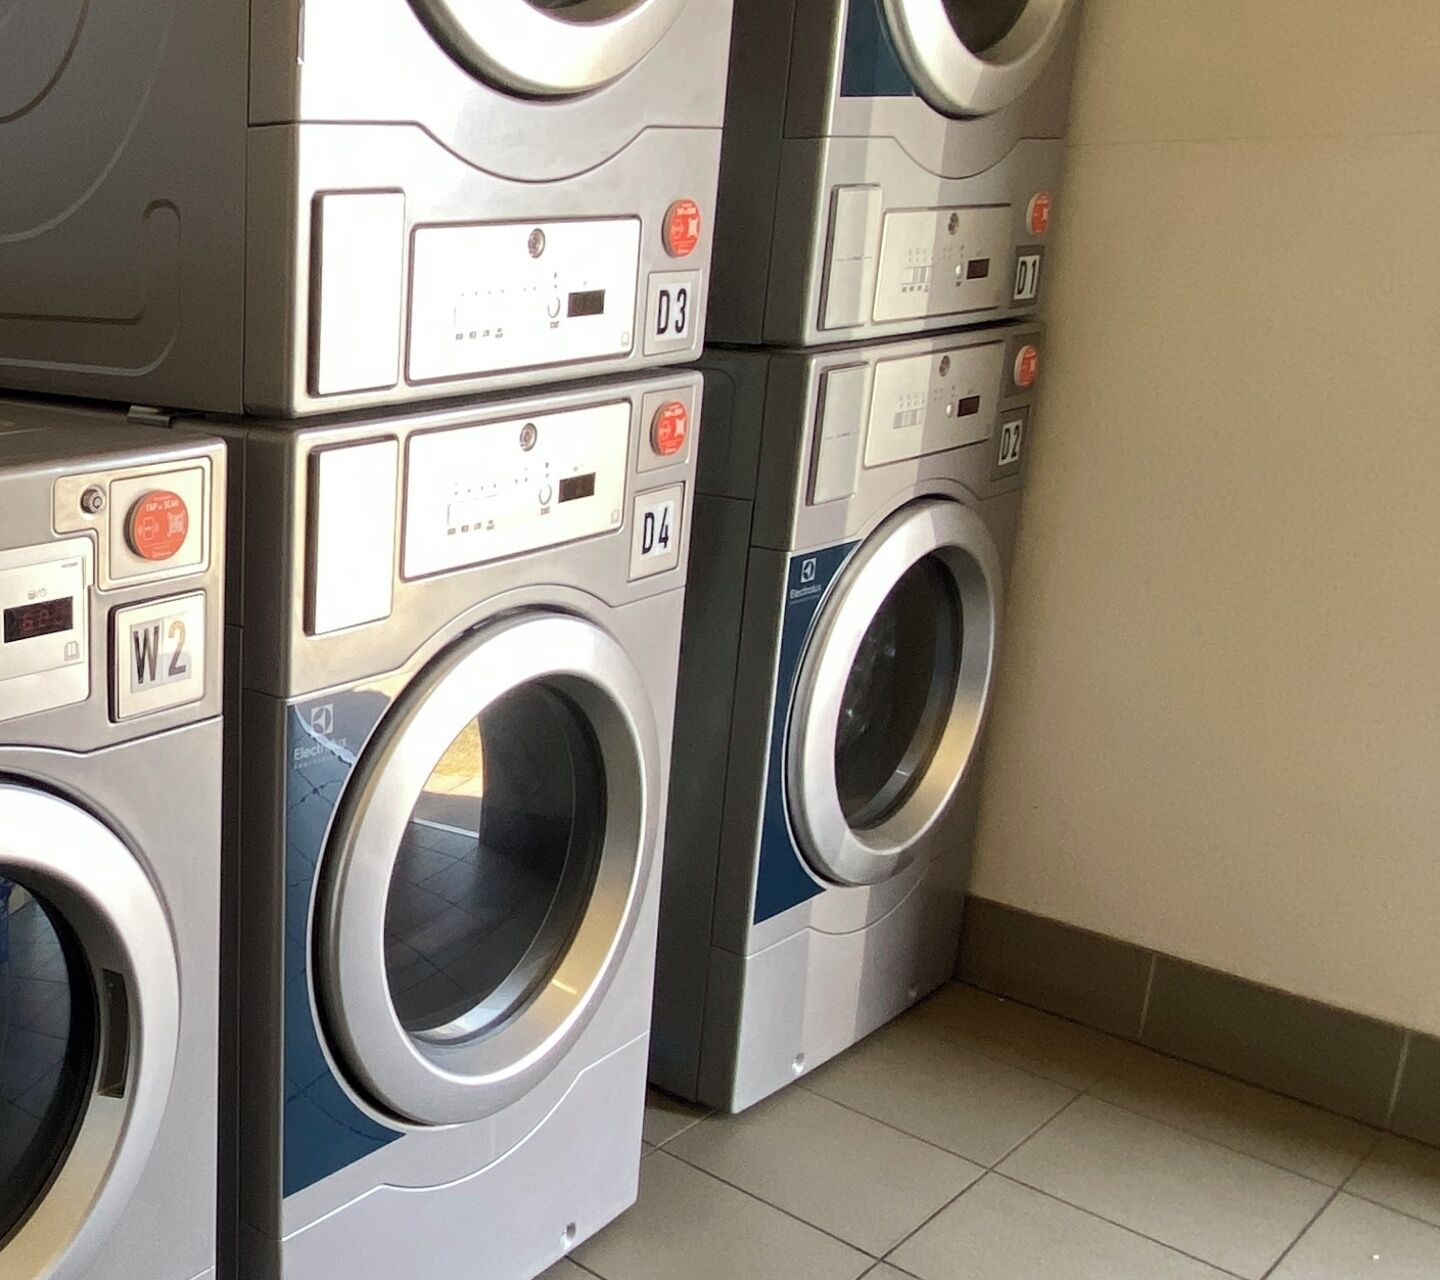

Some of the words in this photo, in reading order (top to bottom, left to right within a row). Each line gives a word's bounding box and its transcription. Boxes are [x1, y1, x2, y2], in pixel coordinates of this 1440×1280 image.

[1017, 260, 1037, 294] D1
[657, 288, 688, 335] D3
[1002, 425, 1020, 460] D2
[641, 506, 670, 555] D4
[132, 620, 187, 685] W2
